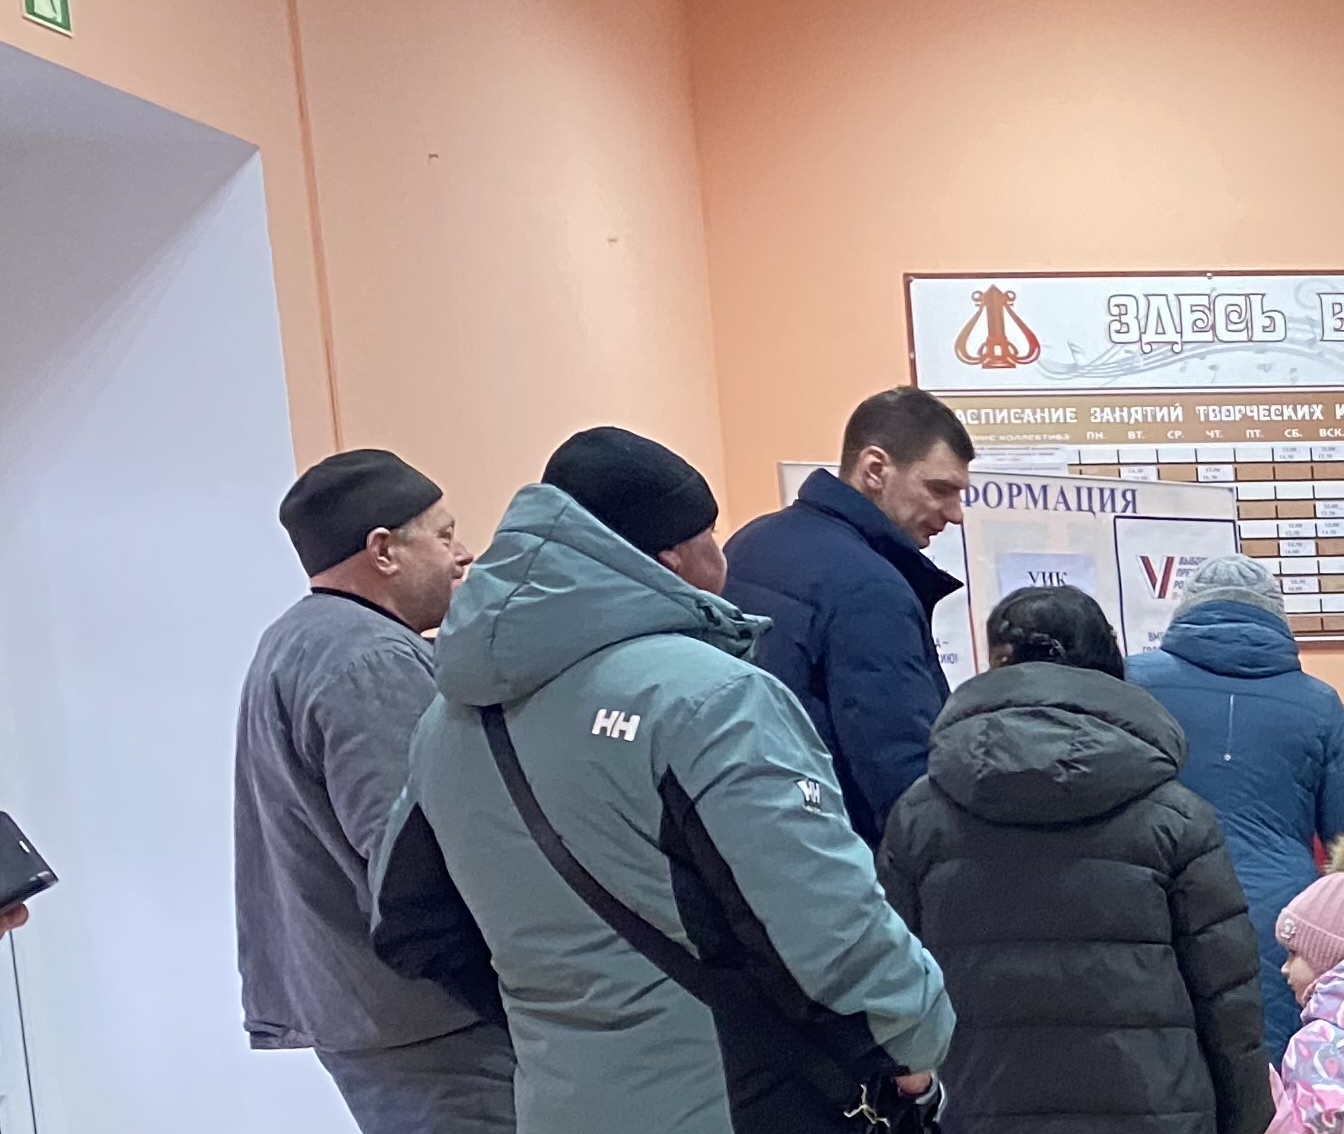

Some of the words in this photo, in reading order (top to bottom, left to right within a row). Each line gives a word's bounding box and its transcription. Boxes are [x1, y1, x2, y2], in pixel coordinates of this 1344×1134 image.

[1107, 293, 1287, 354] ЗДЕСЬ
[957, 407, 1078, 425] АСПИСАНИЕ
[1090, 403, 1184, 424] ЗАНЯТИЙ
[1196, 403, 1324, 421] ТВОРЧЕСКИХ
[960, 481, 1139, 517] ФОРМАЦИЯ
[1027, 571, 1068, 587] УИК
[591, 709, 641, 742] HH
